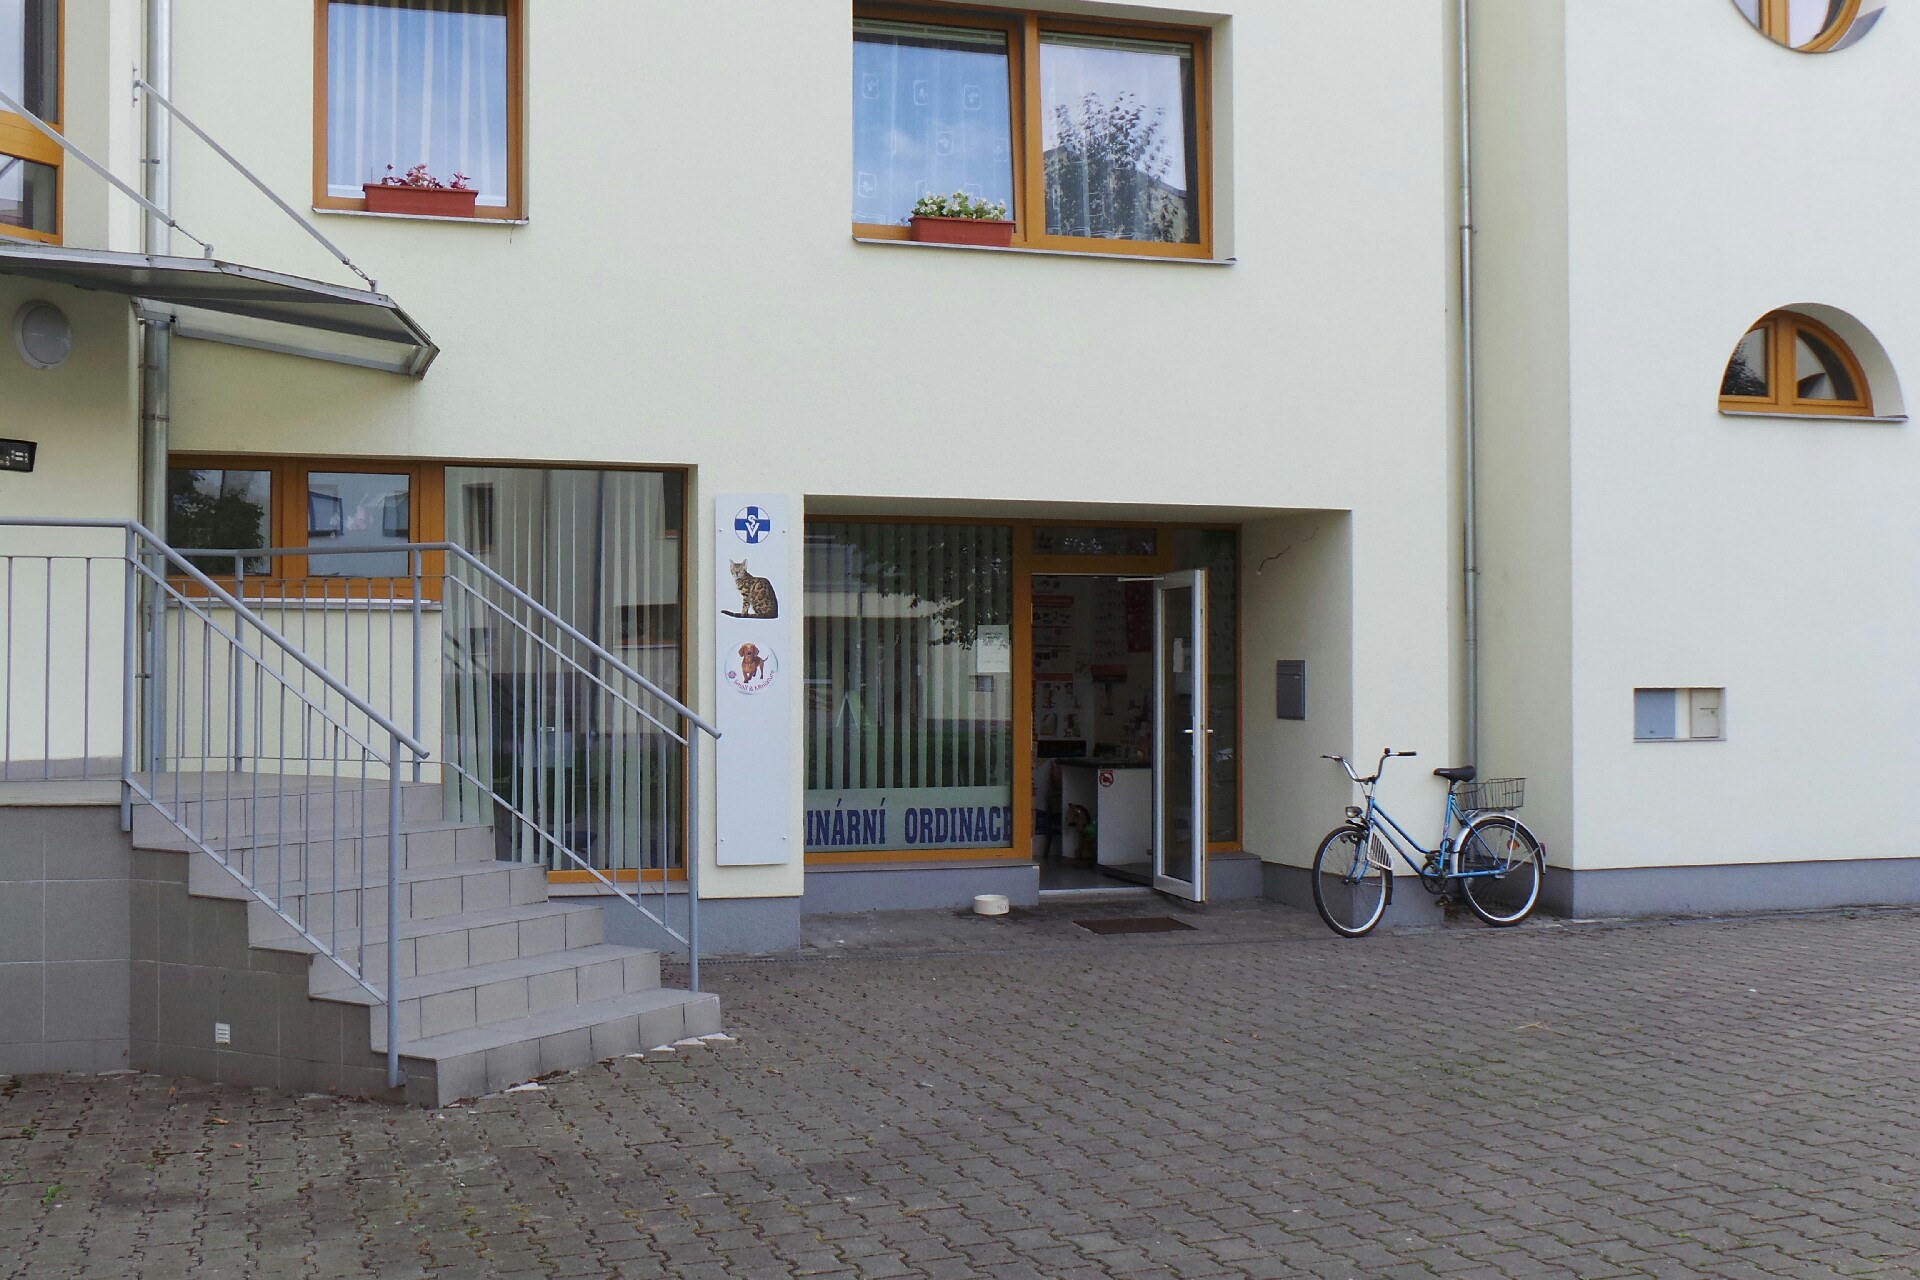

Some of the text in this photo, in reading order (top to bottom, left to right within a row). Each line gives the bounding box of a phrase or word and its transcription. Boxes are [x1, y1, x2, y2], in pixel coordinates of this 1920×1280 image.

[734, 680, 748, 690] Small
[755, 669, 775, 691] Miniature
[804, 797, 886, 846] INÁRNÍ
